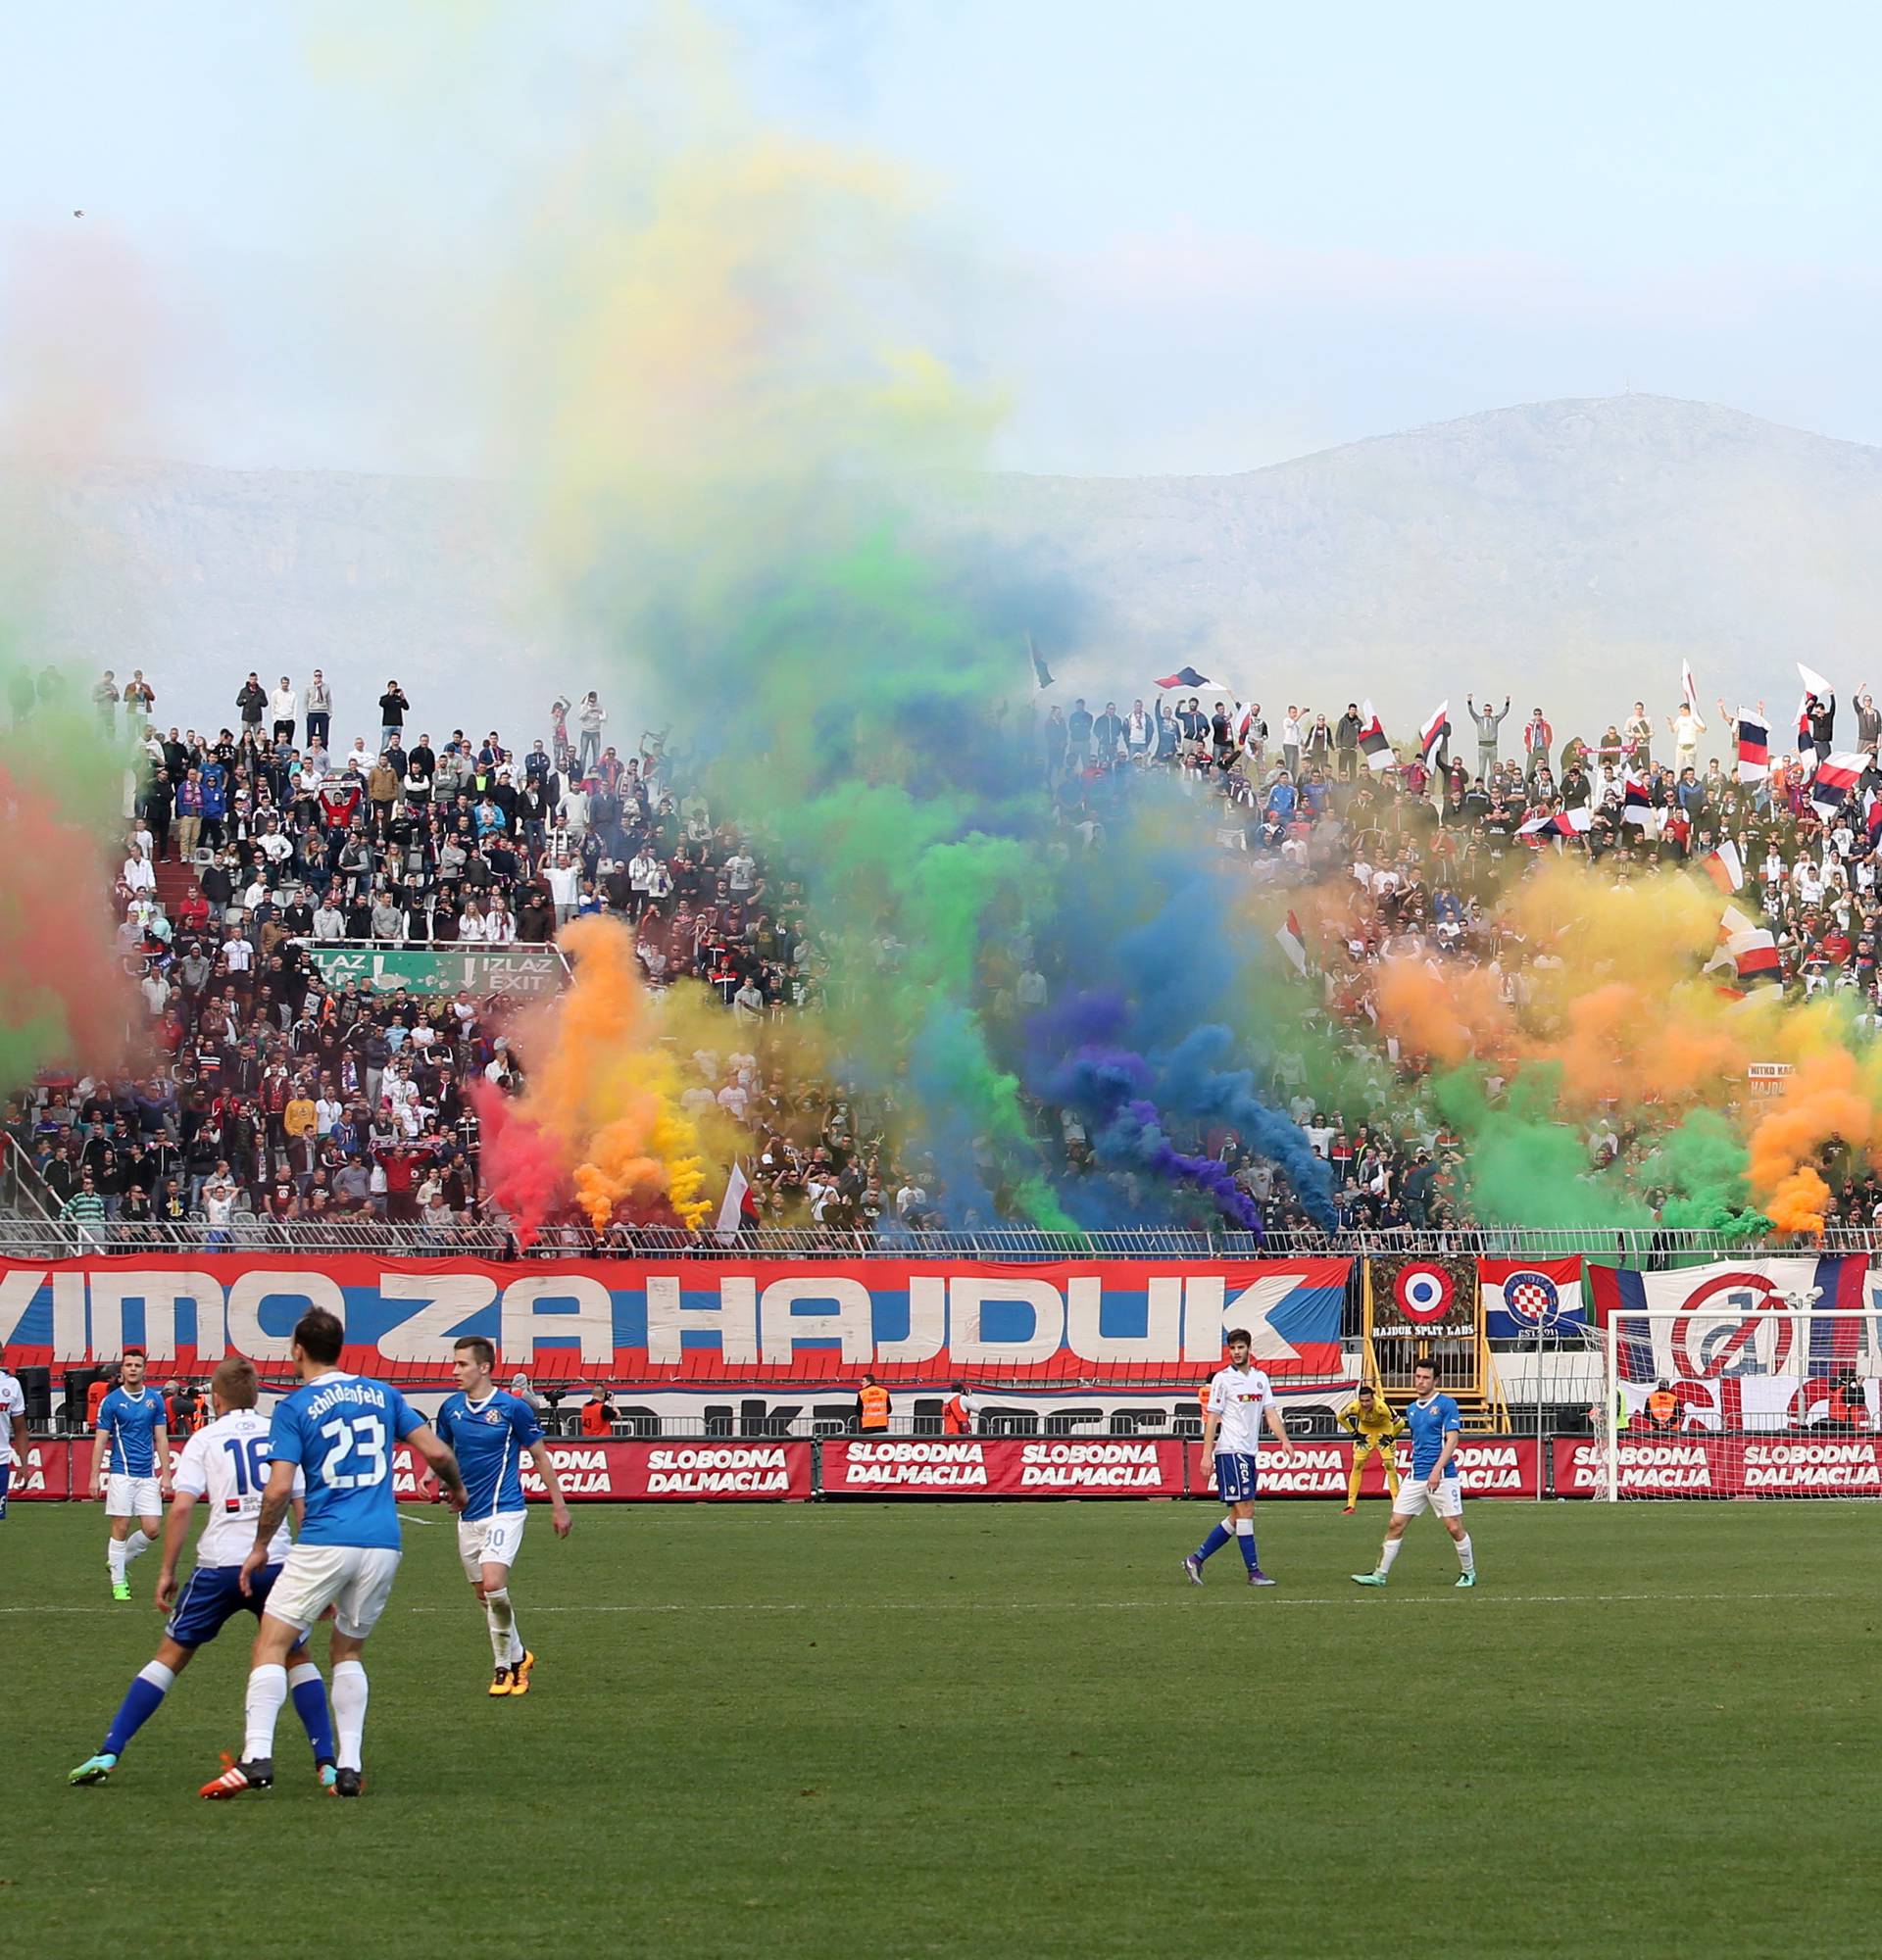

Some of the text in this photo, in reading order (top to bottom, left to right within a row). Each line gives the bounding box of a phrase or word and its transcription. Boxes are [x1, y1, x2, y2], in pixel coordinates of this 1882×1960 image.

[311, 955, 367, 969] LAZ
[482, 956, 553, 972] IZLAZ
[321, 971, 358, 986] XIT
[489, 975, 545, 990] EXIT
[376, 1272, 615, 1365] ZA
[646, 1275, 1309, 1365] HAJDUK
[1372, 1324, 1475, 1338] HAJDUK SPLIT LADS
[307, 1383, 386, 1421] schildenfeld
[321, 1414, 388, 1490] 23
[647, 1448, 786, 1470] SLOBODNA
[846, 1442, 984, 1463] SLOBODNA
[1020, 1445, 1159, 1464] SLOBODNA
[1213, 1450, 1343, 1470] BODNA
[1743, 1444, 1876, 1465] SLOBODNA
[223, 1436, 271, 1495] 16
[846, 1464, 988, 1485] DALMACIJA
[1744, 1465, 1881, 1487] DALMACIJA
[647, 1471, 790, 1493] DALMACIJA
[1020, 1466, 1163, 1487] DALMACIJA
[1208, 1472, 1348, 1492] MACIJA
